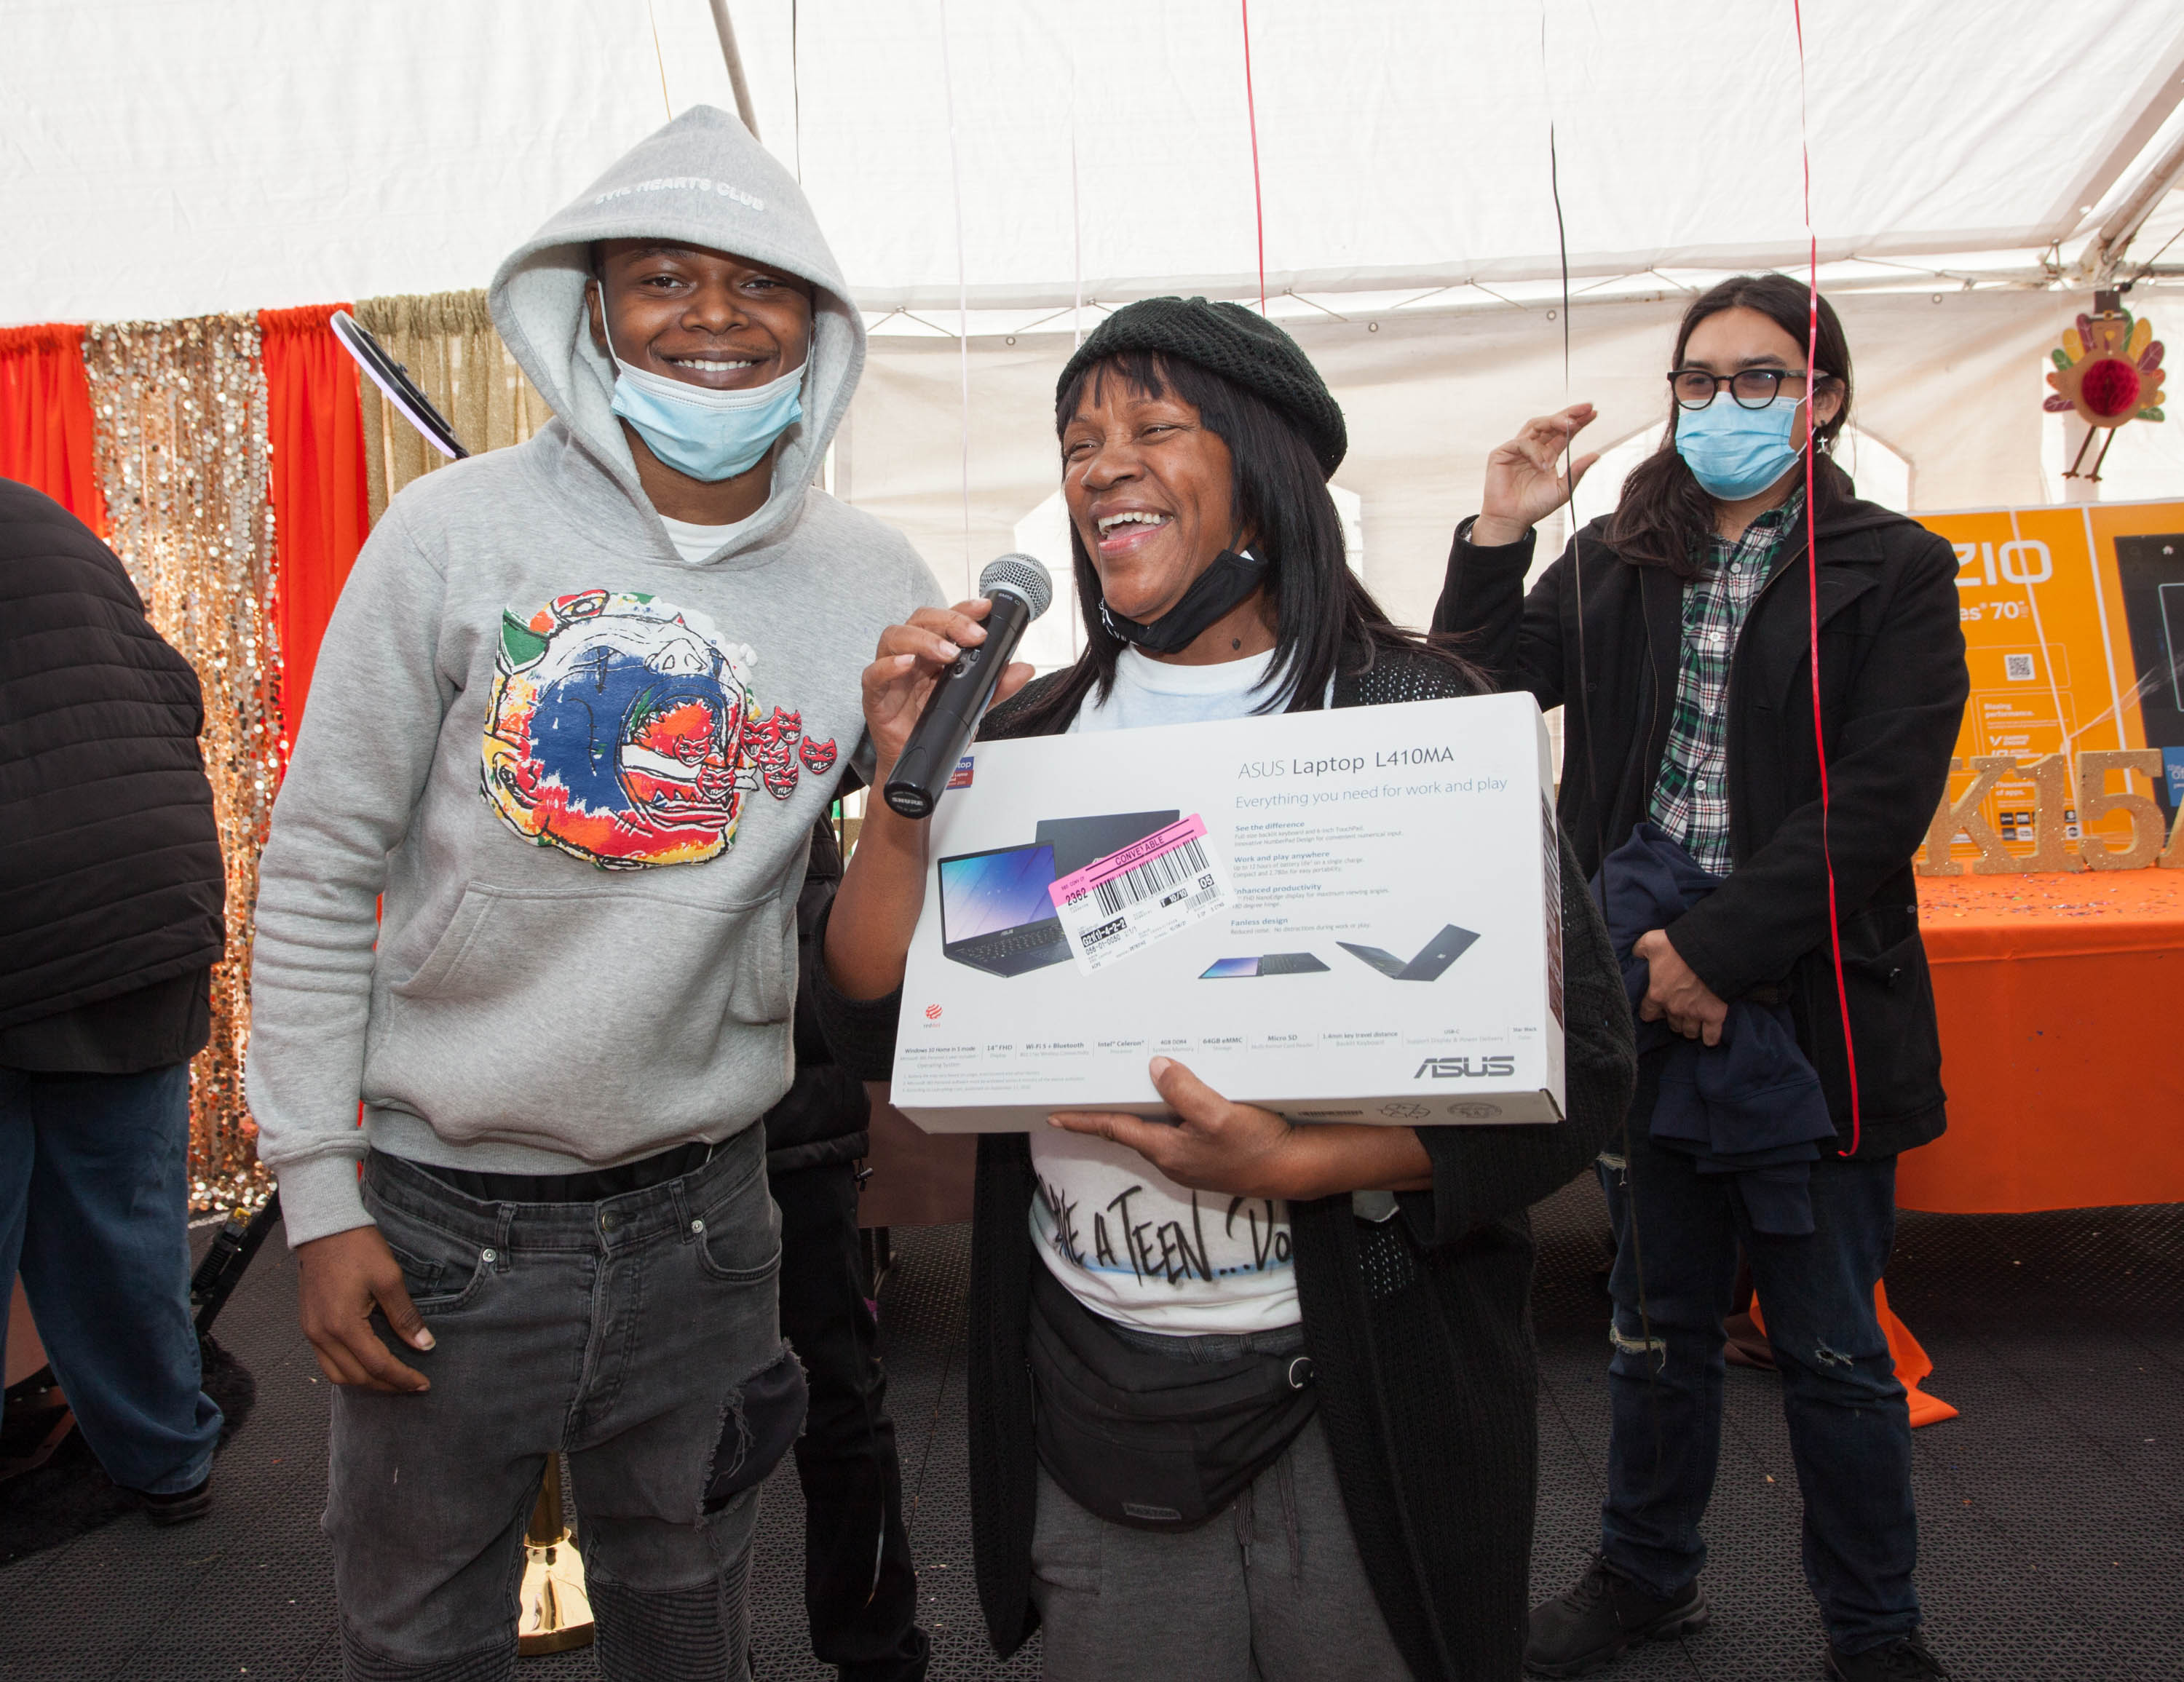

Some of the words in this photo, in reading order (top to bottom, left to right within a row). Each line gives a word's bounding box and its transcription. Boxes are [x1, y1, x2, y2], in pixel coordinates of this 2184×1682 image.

[716, 181, 764, 212] CLUB
[1951, 540, 2052, 587] ZIO
[1238, 761, 1285, 779] ASUS
[1293, 756, 1365, 777] Laptop
[1376, 746, 1455, 767] L410MA
[1235, 792, 1309, 809] Everything
[1313, 791, 1338, 806] you
[1342, 786, 1379, 801] need
[1382, 784, 1401, 798] for
[1405, 781, 1441, 796] work
[1445, 777, 1472, 793] and
[1477, 776, 1508, 793] play
[892, 797, 924, 806] SHURE
[1265, 821, 1305, 830] difference
[1278, 830, 1305, 838] keyboard
[1273, 852, 1289, 862] play
[1291, 850, 1330, 860] anywhere
[1280, 860, 1299, 868] battery
[1233, 870, 1257, 878] Compact
[1200, 876, 1214, 889] 05
[1273, 883, 1322, 894] productivity
[1065, 887, 1089, 907] 2362
[1168, 888, 1188, 903] 10/10
[1230, 919, 1260, 927] Fanless
[1262, 916, 1288, 927] design
[1230, 927, 1254, 935] Reduced
[1316, 922, 1334, 931] during
[1267, 1034, 1287, 1042] Micro
[999, 1043, 1013, 1051] FHD
[1414, 1055, 1515, 1079] ASUS
[1094, 1212, 1117, 1267] A
